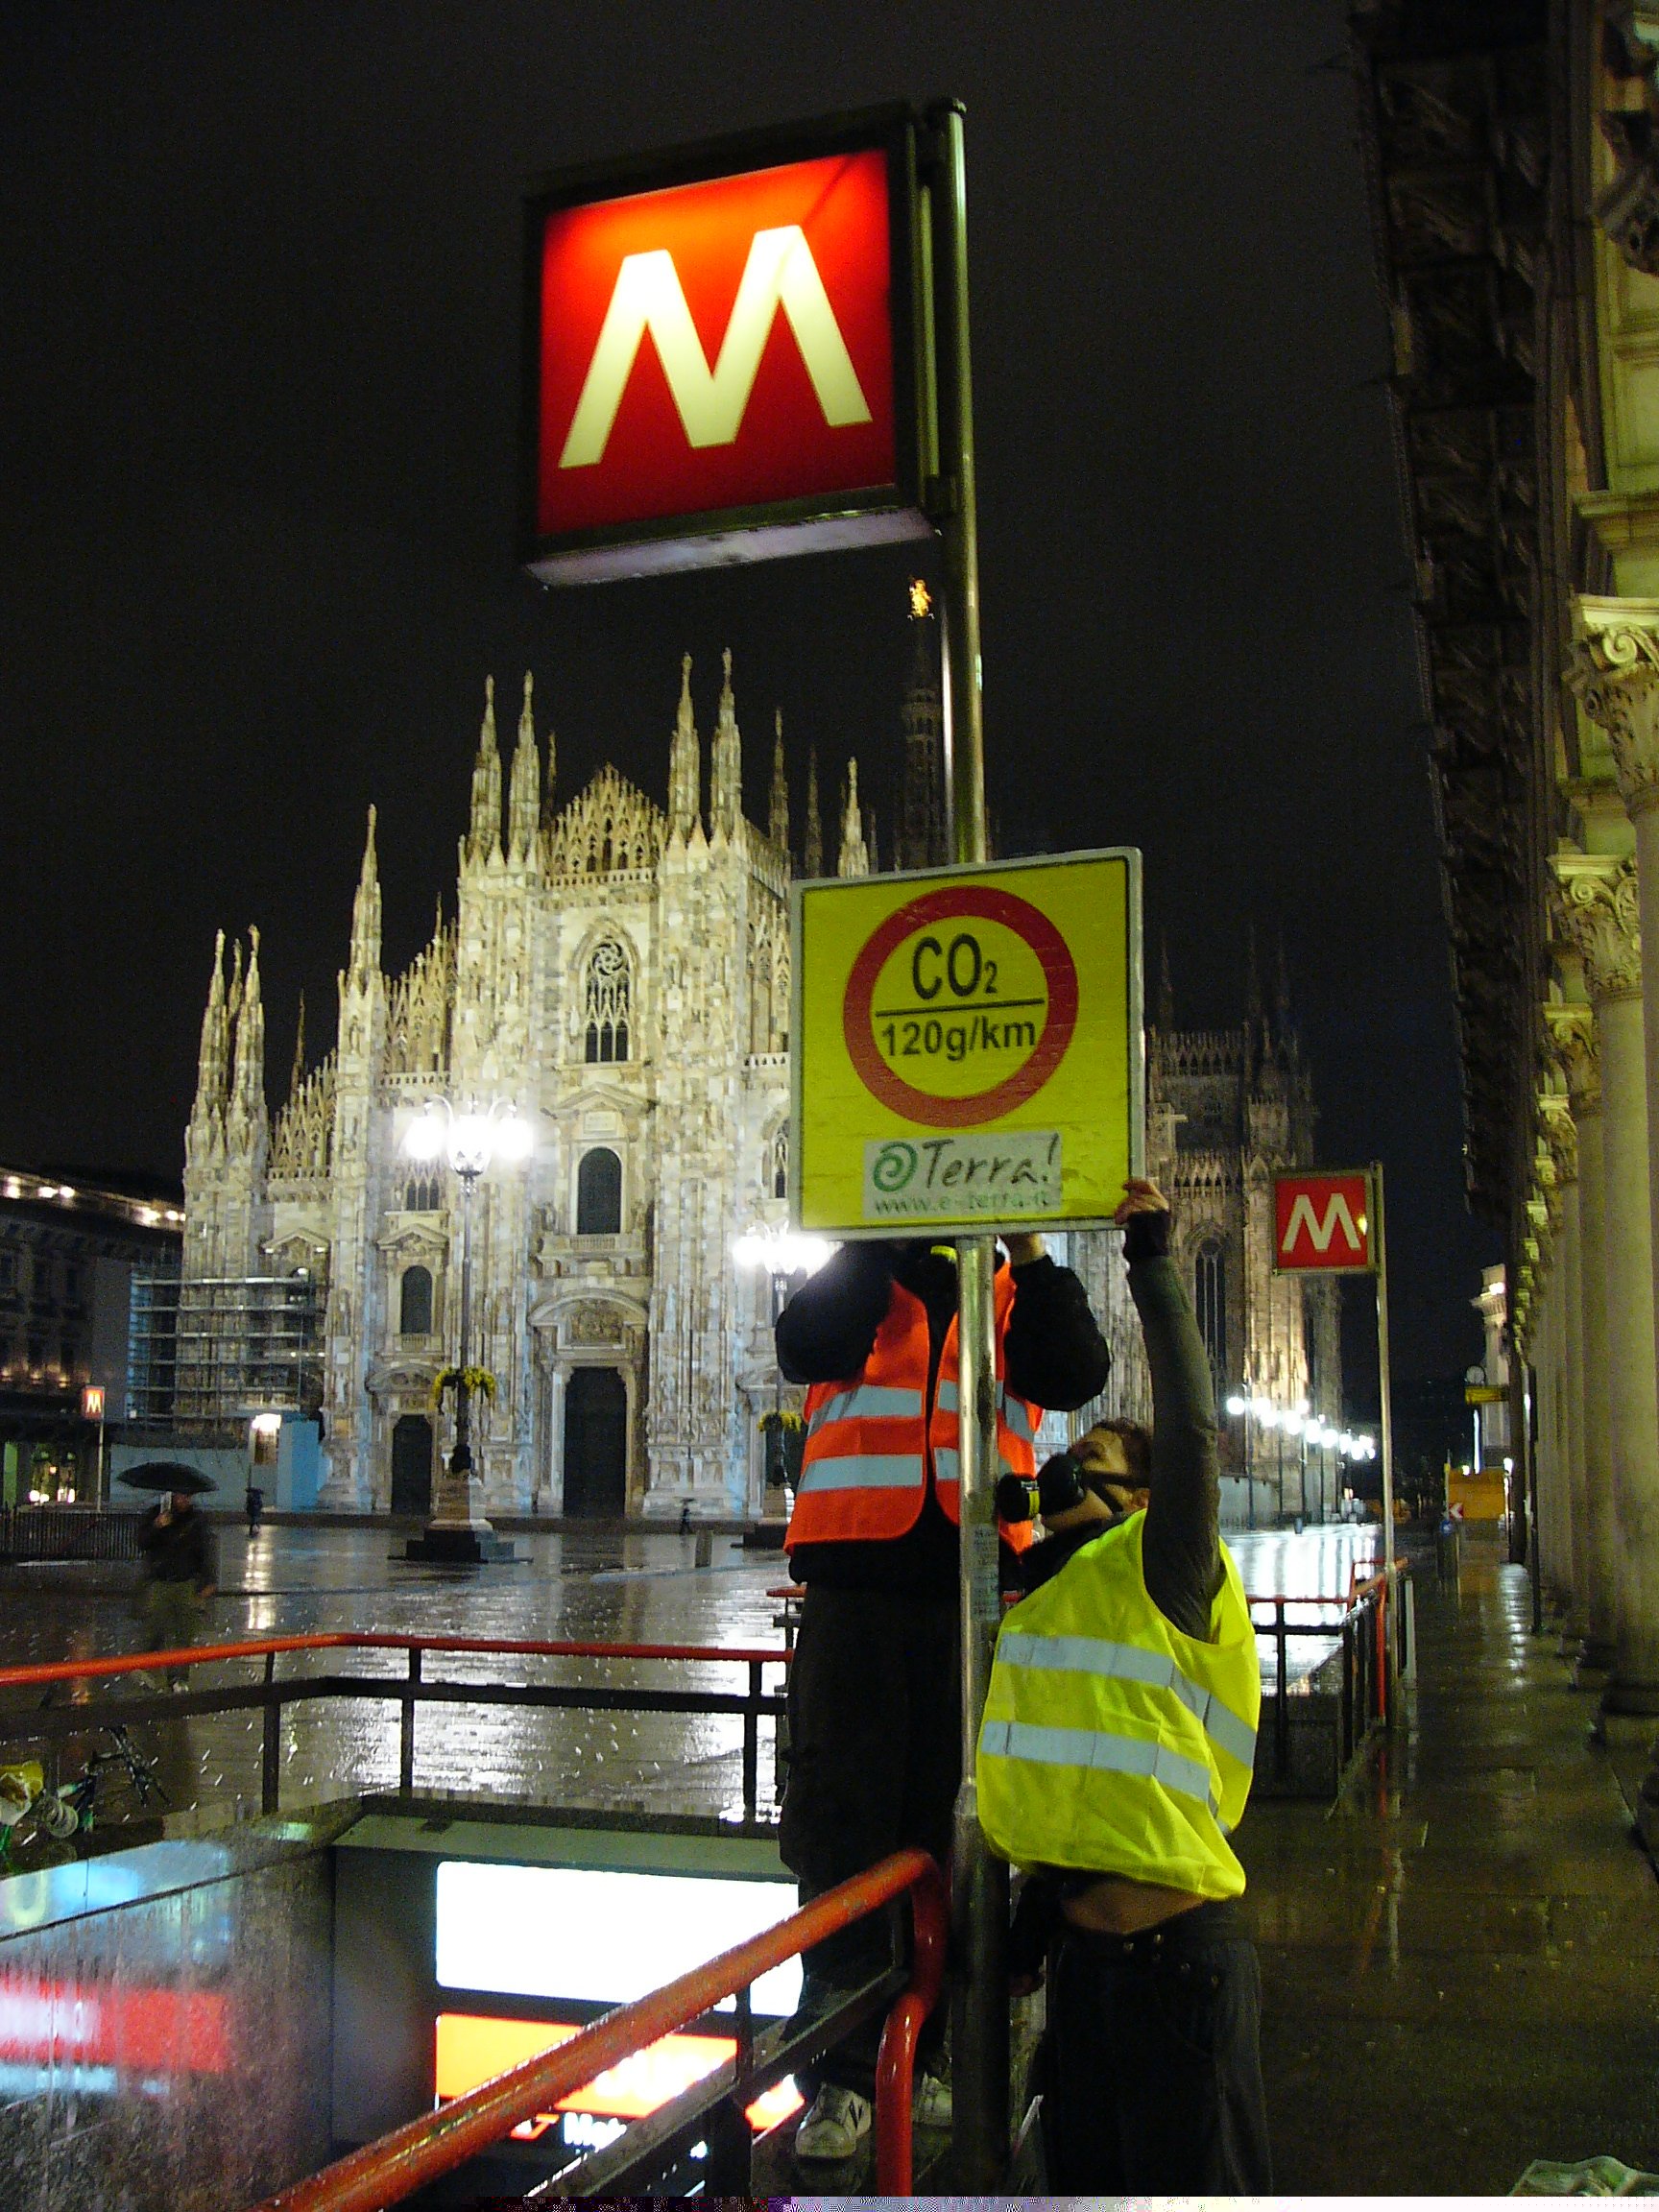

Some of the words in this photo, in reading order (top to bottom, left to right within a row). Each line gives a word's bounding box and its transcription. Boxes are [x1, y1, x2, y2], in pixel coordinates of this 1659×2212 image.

[559, 225, 873, 469] M
[913, 933, 998, 999] CO2
[881, 1016, 1036, 1062] 120g/km
[1282, 1192, 1361, 1253] M
[86, 1393, 102, 1413] M
